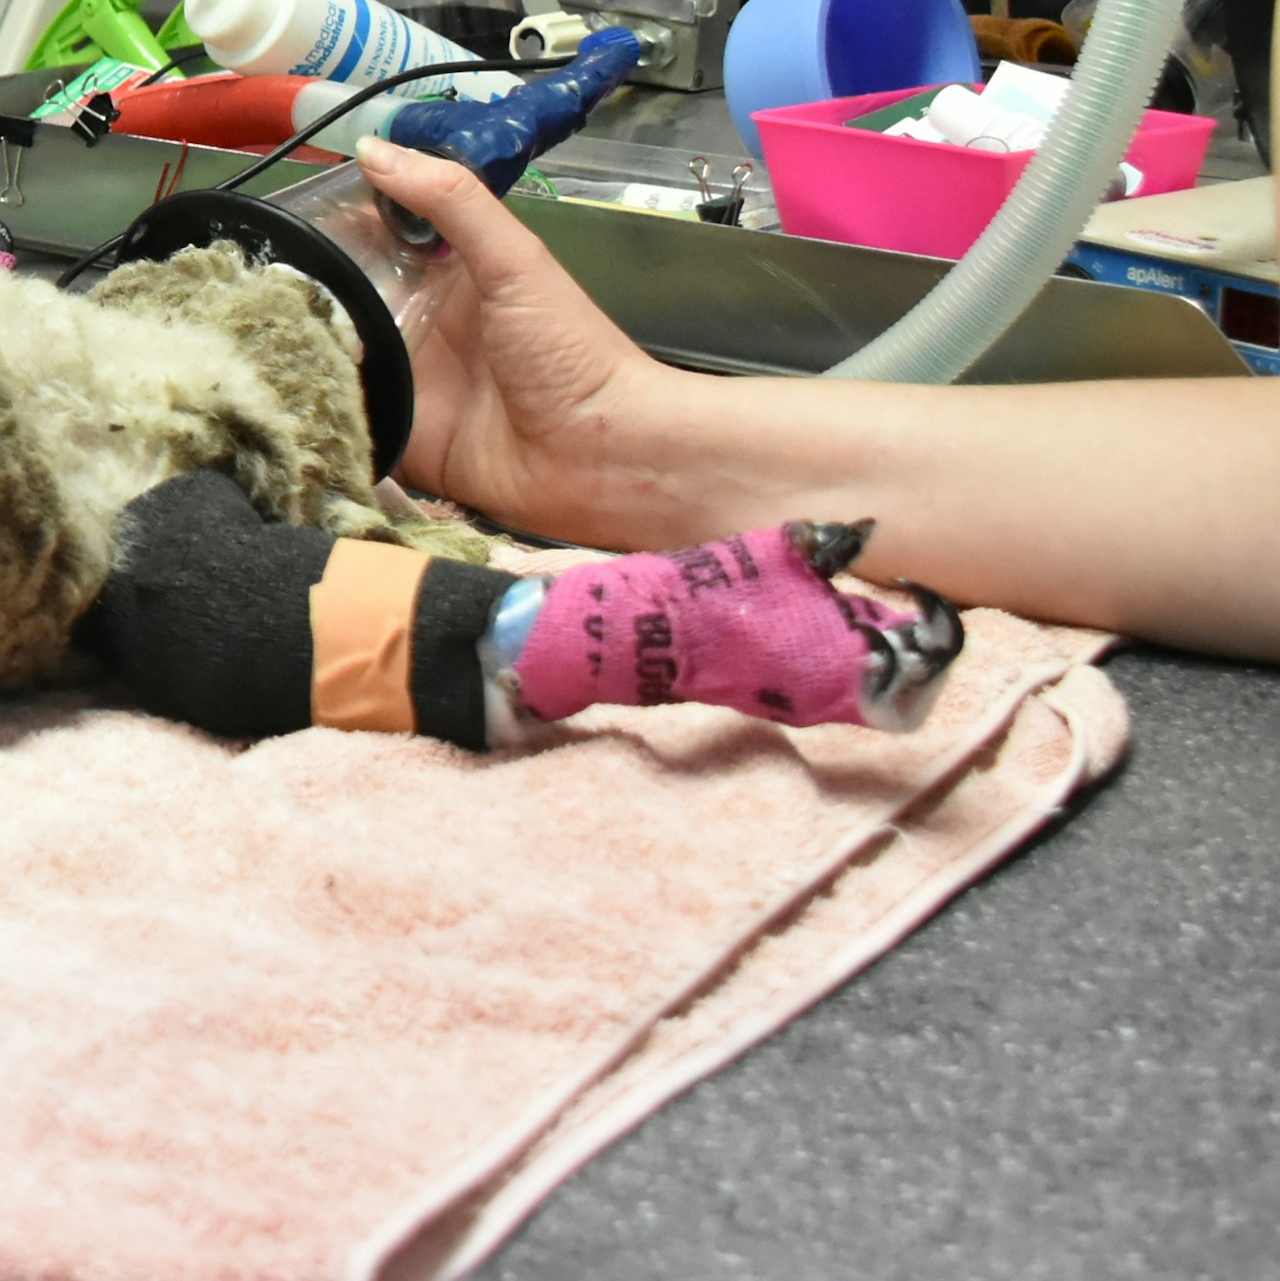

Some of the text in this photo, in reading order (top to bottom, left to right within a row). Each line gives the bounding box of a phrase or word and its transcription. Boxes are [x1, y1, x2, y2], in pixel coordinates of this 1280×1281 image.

[304, 1, 337, 65] medical
[310, 8, 347, 77] industries
[364, 16, 389, 79] SUNSONIC
